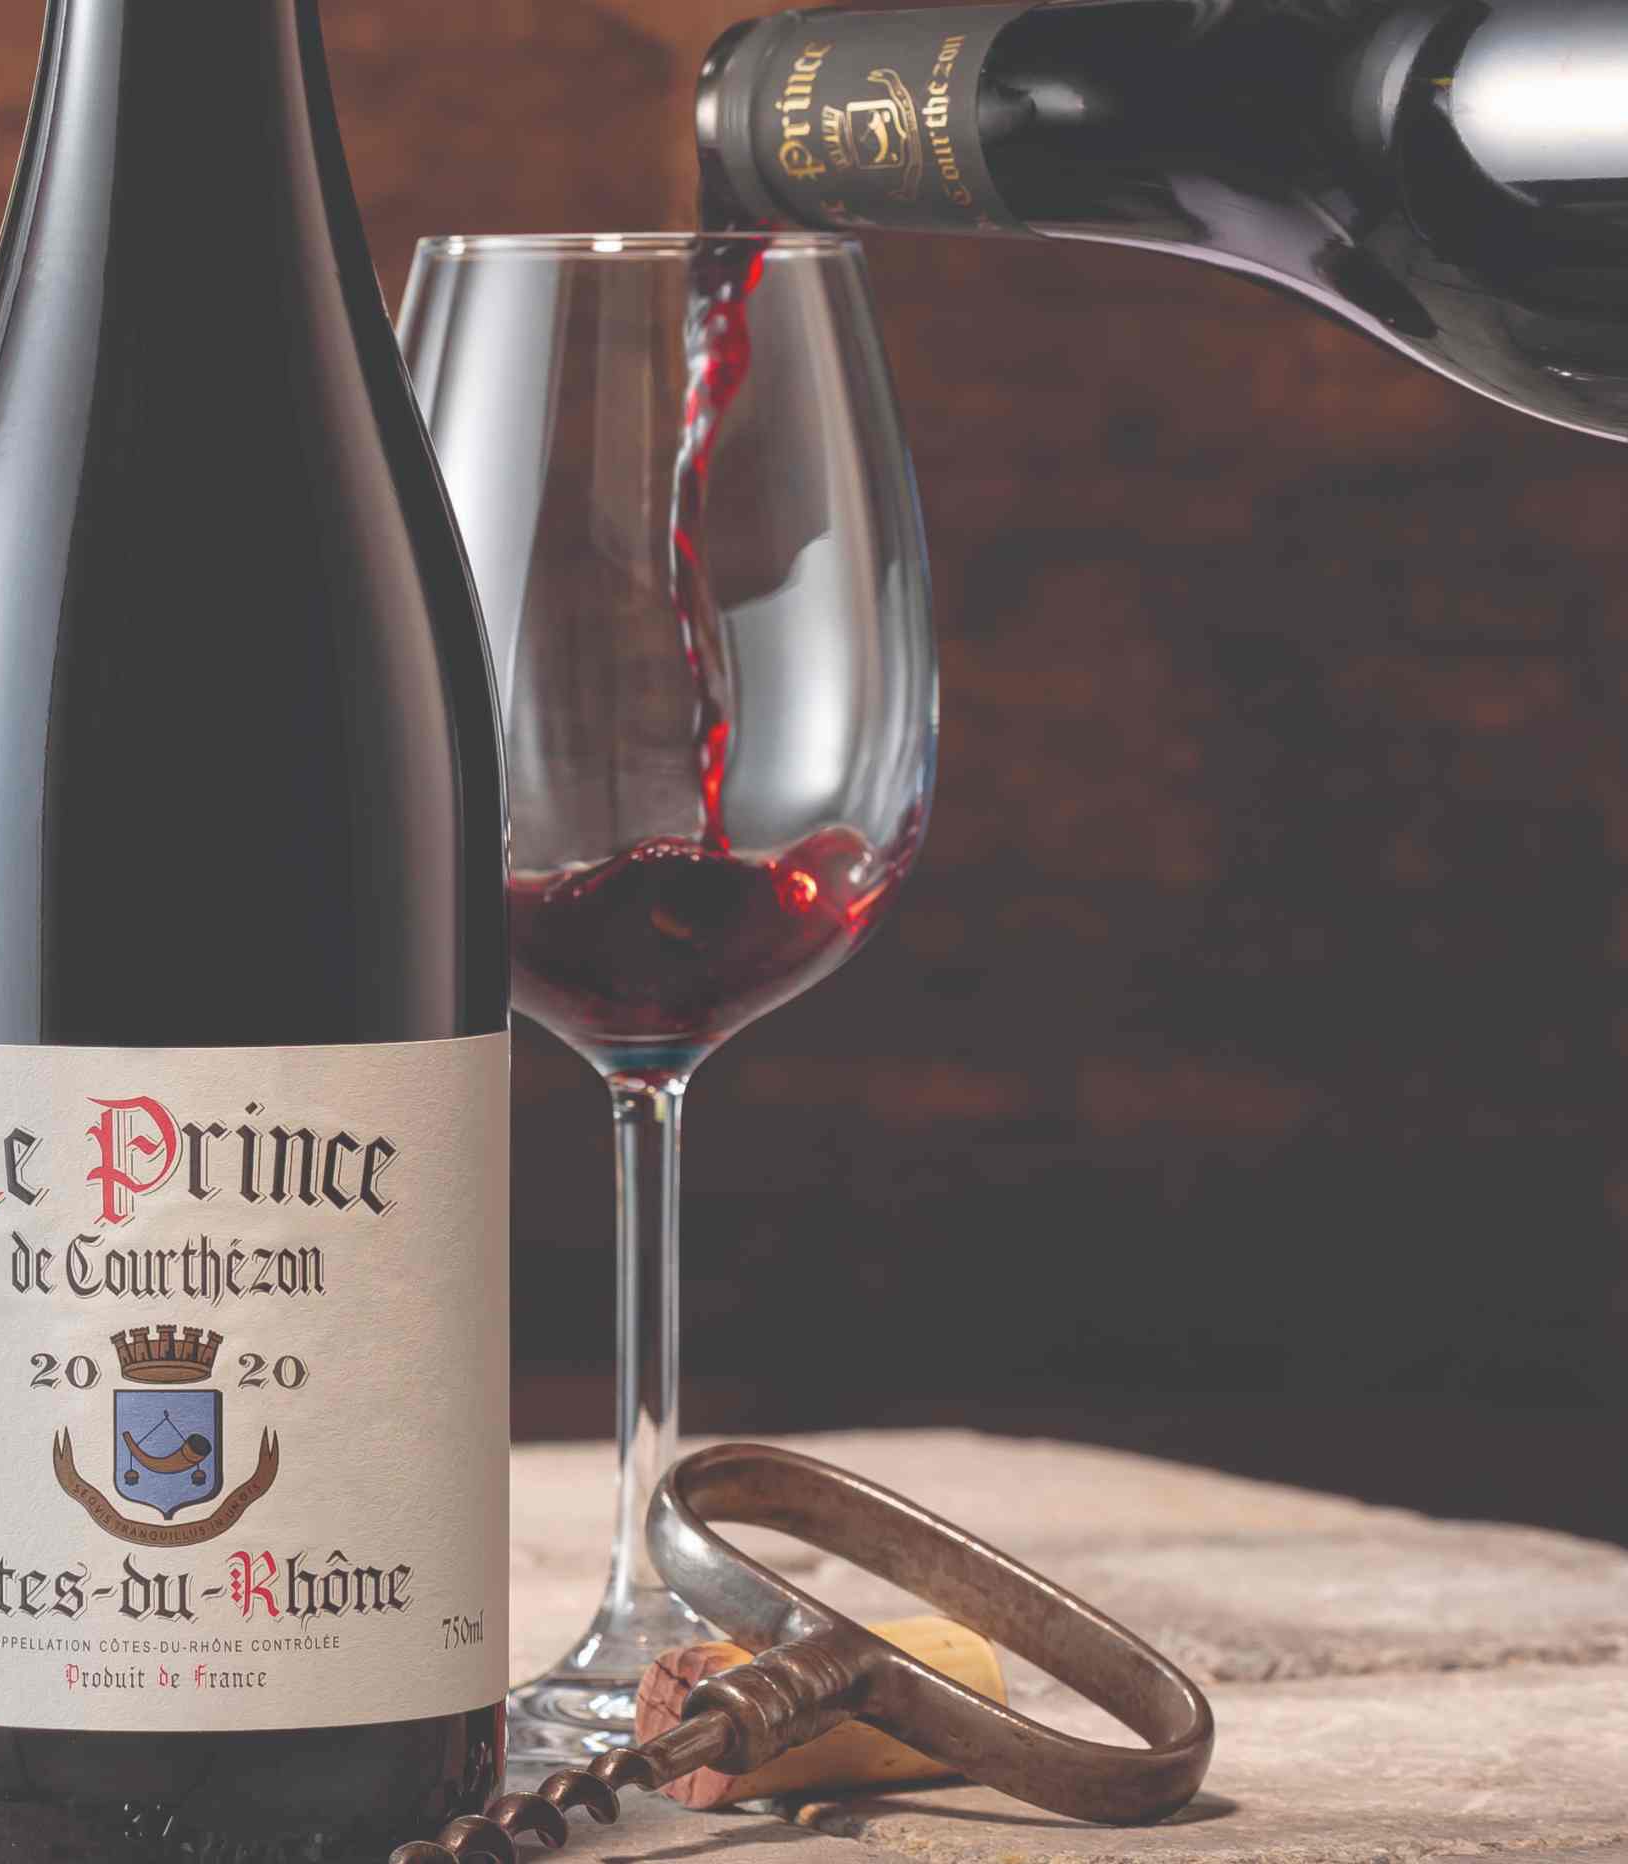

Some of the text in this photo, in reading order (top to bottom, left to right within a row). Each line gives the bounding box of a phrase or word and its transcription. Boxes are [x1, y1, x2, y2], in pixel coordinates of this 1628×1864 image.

[775, 42, 833, 180] Prince
[85, 1095, 401, 1227] Prince
[11, 1231, 327, 1306] de Courthézon
[29, 1352, 310, 1390] 20 20
[99, 1638, 243, 1654] CÔTES-DU-RHÔNE
[251, 1635, 341, 1653] CONTRÔLÉE
[442, 1608, 484, 1650] 750ml
[65, 1663, 268, 1693] Produit de France
